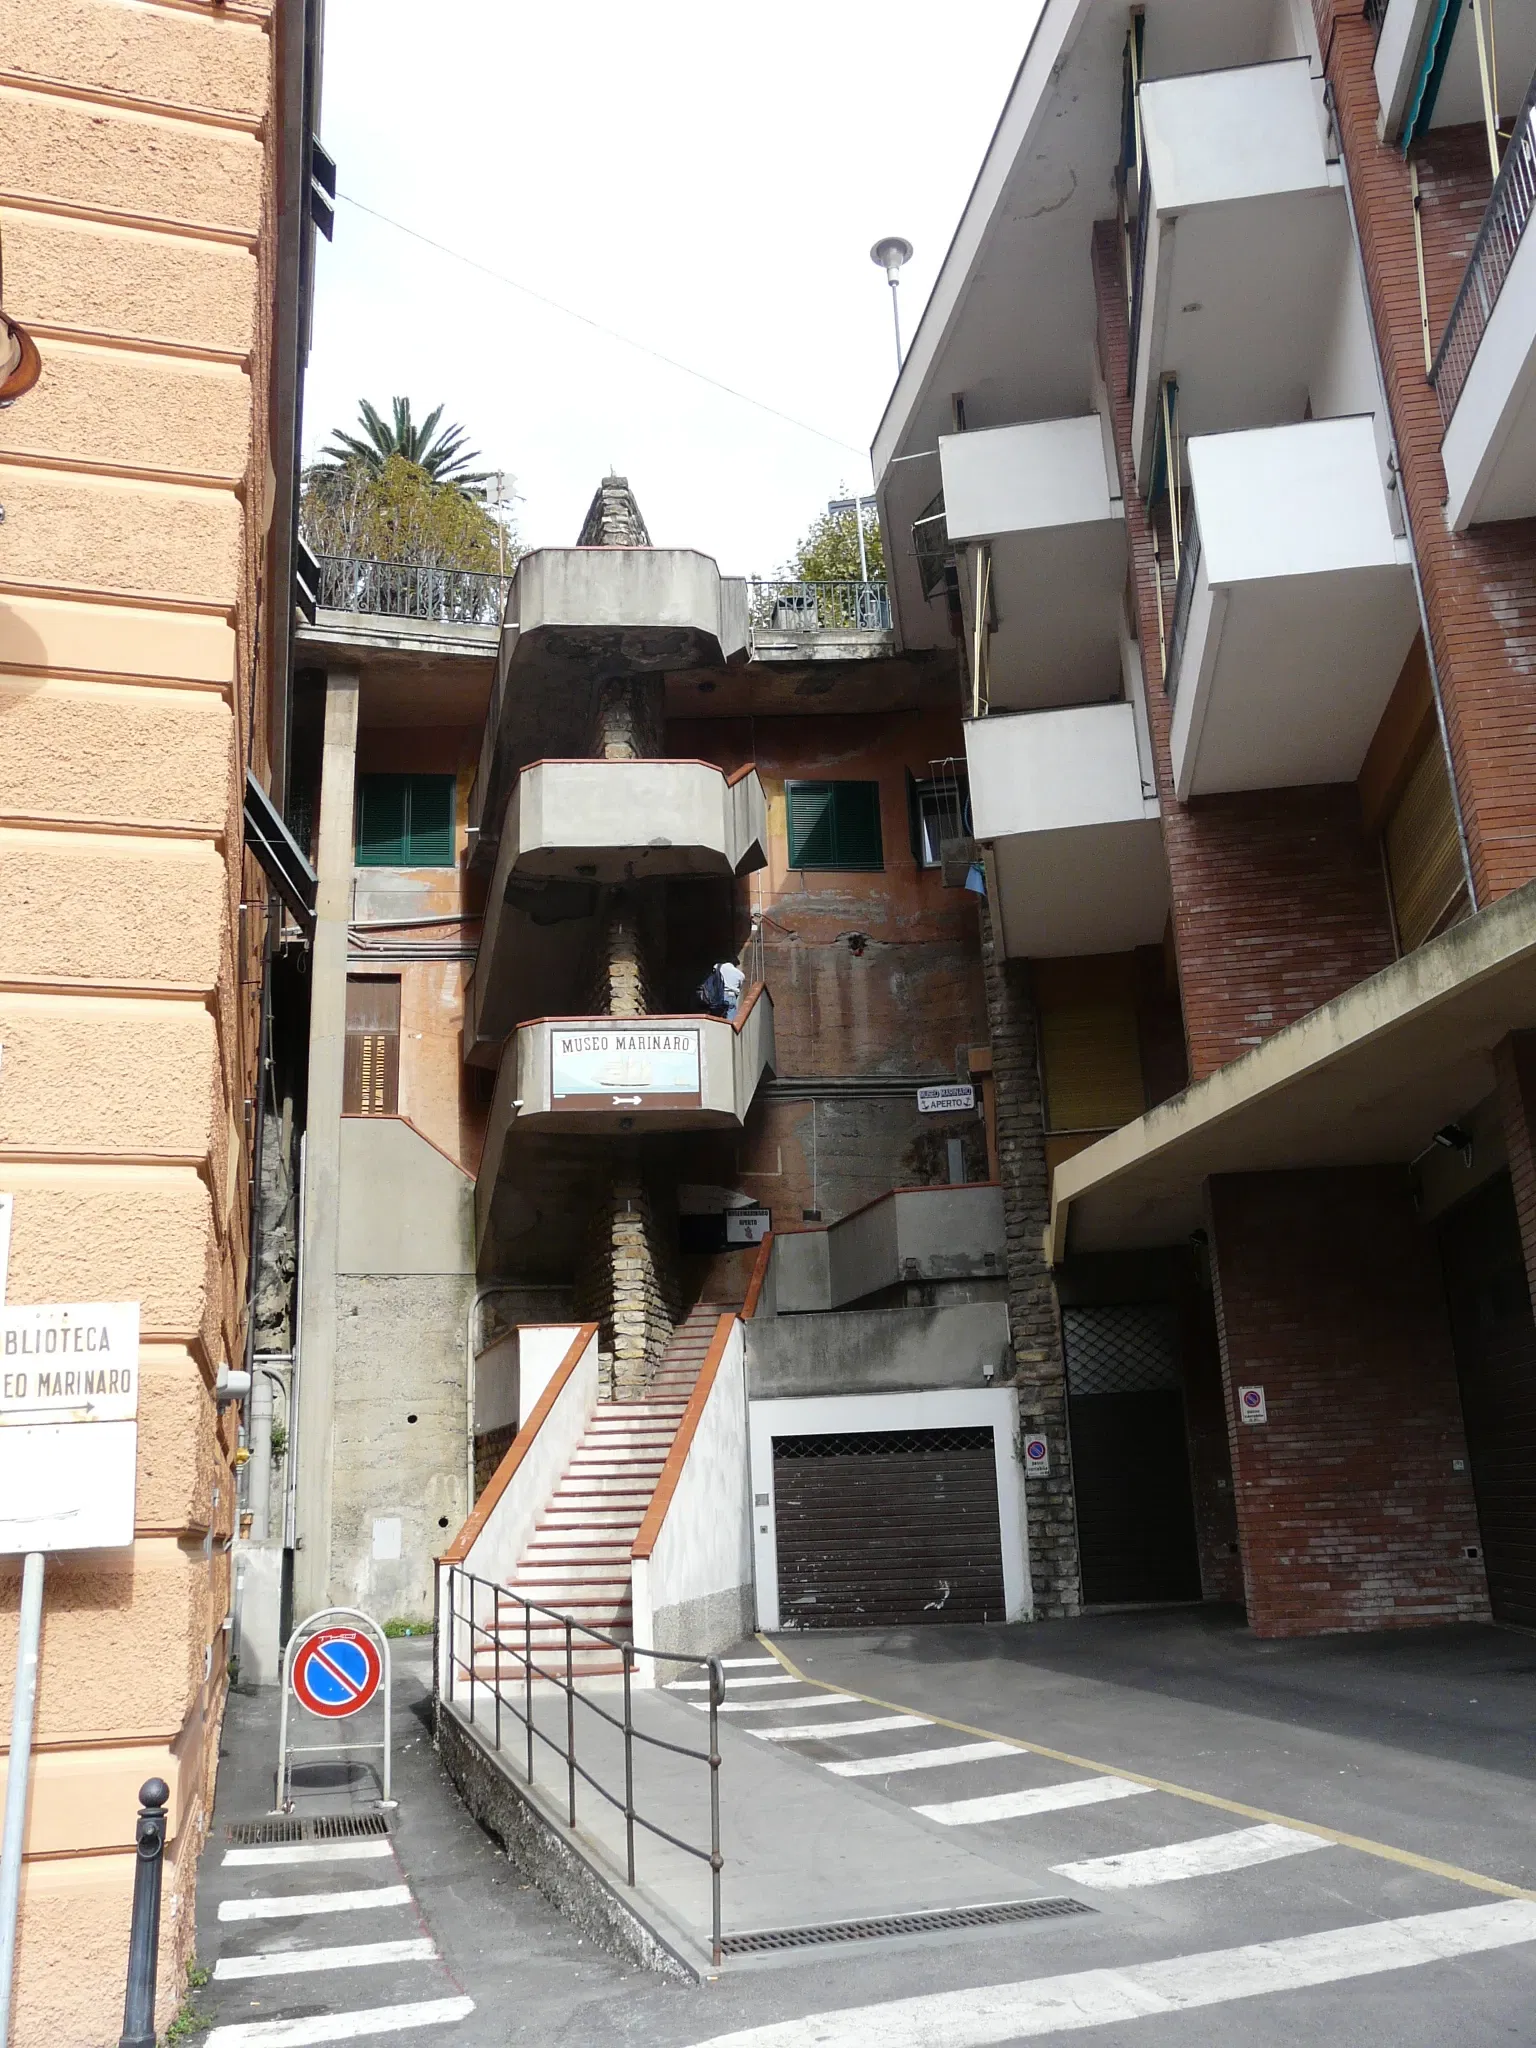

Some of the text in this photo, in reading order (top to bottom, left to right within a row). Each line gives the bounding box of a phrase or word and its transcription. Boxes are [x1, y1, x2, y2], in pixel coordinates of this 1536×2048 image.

[562, 1036, 690, 1054] MUSEO MARINARO
[930, 1098, 962, 1108] APERTO
[37, 1368, 131, 1397] MARINARO
